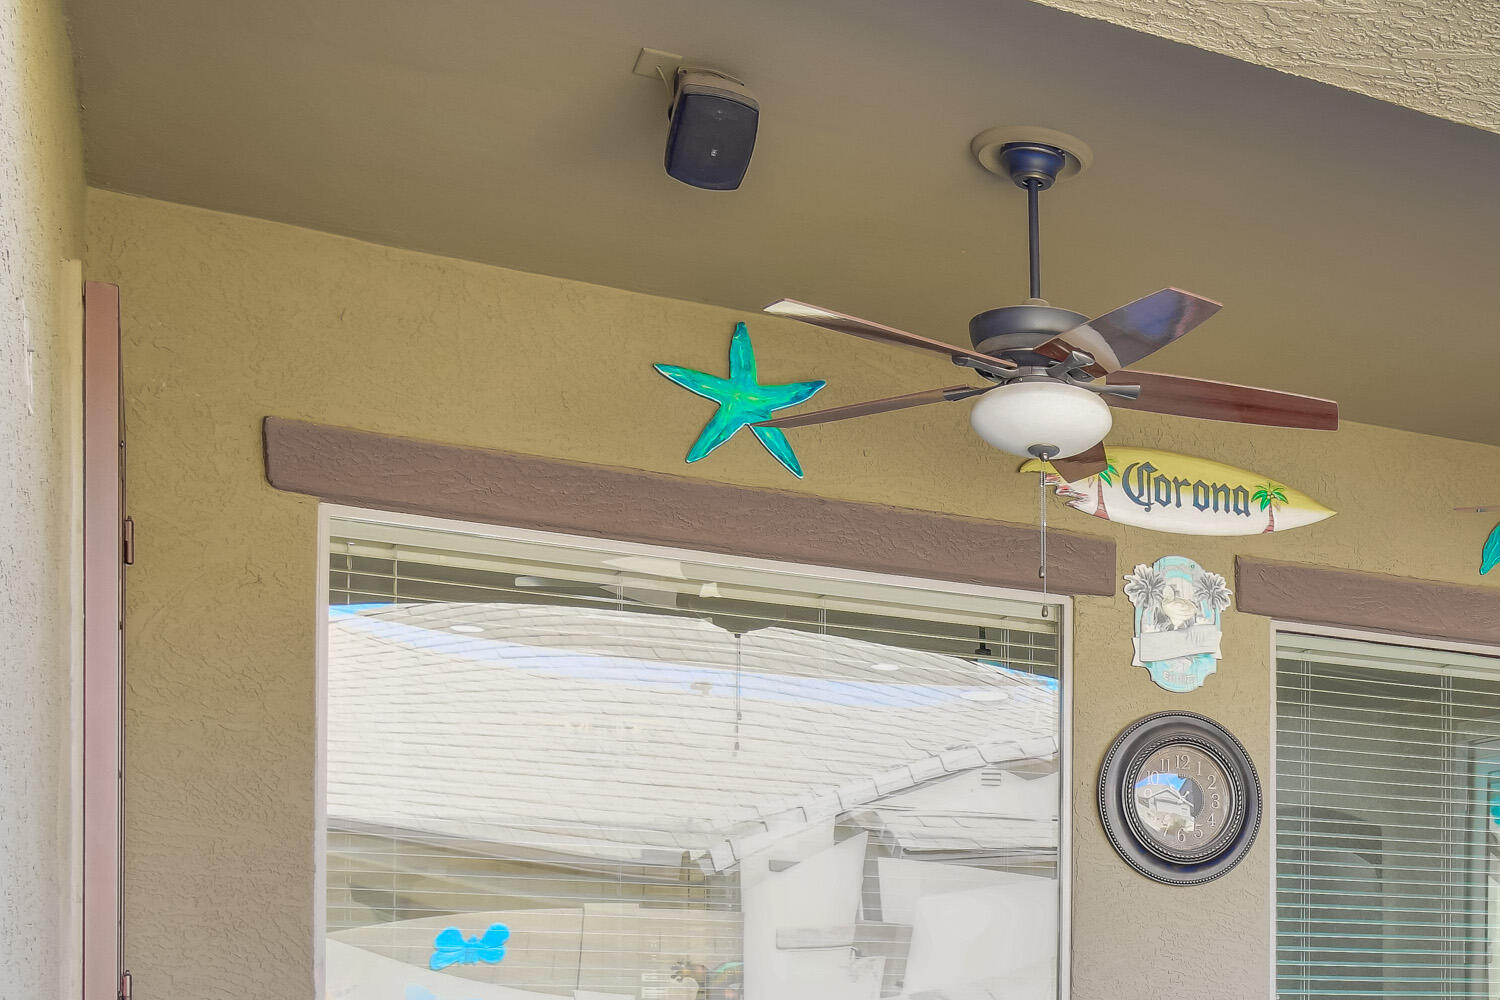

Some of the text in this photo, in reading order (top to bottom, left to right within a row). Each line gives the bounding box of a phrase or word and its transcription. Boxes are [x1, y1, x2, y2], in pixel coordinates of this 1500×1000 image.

[1122, 462, 1250, 517] Corona
[1160, 758, 1170, 773] 11
[1175, 754, 1190, 770] 12
[1147, 770, 1159, 785] 10
[1207, 775, 1216, 790] 2
[1211, 793, 1219, 809] 3
[1207, 814, 1216, 828] 4
[1177, 828, 1185, 843] 6
[1194, 824, 1203, 838] 5
